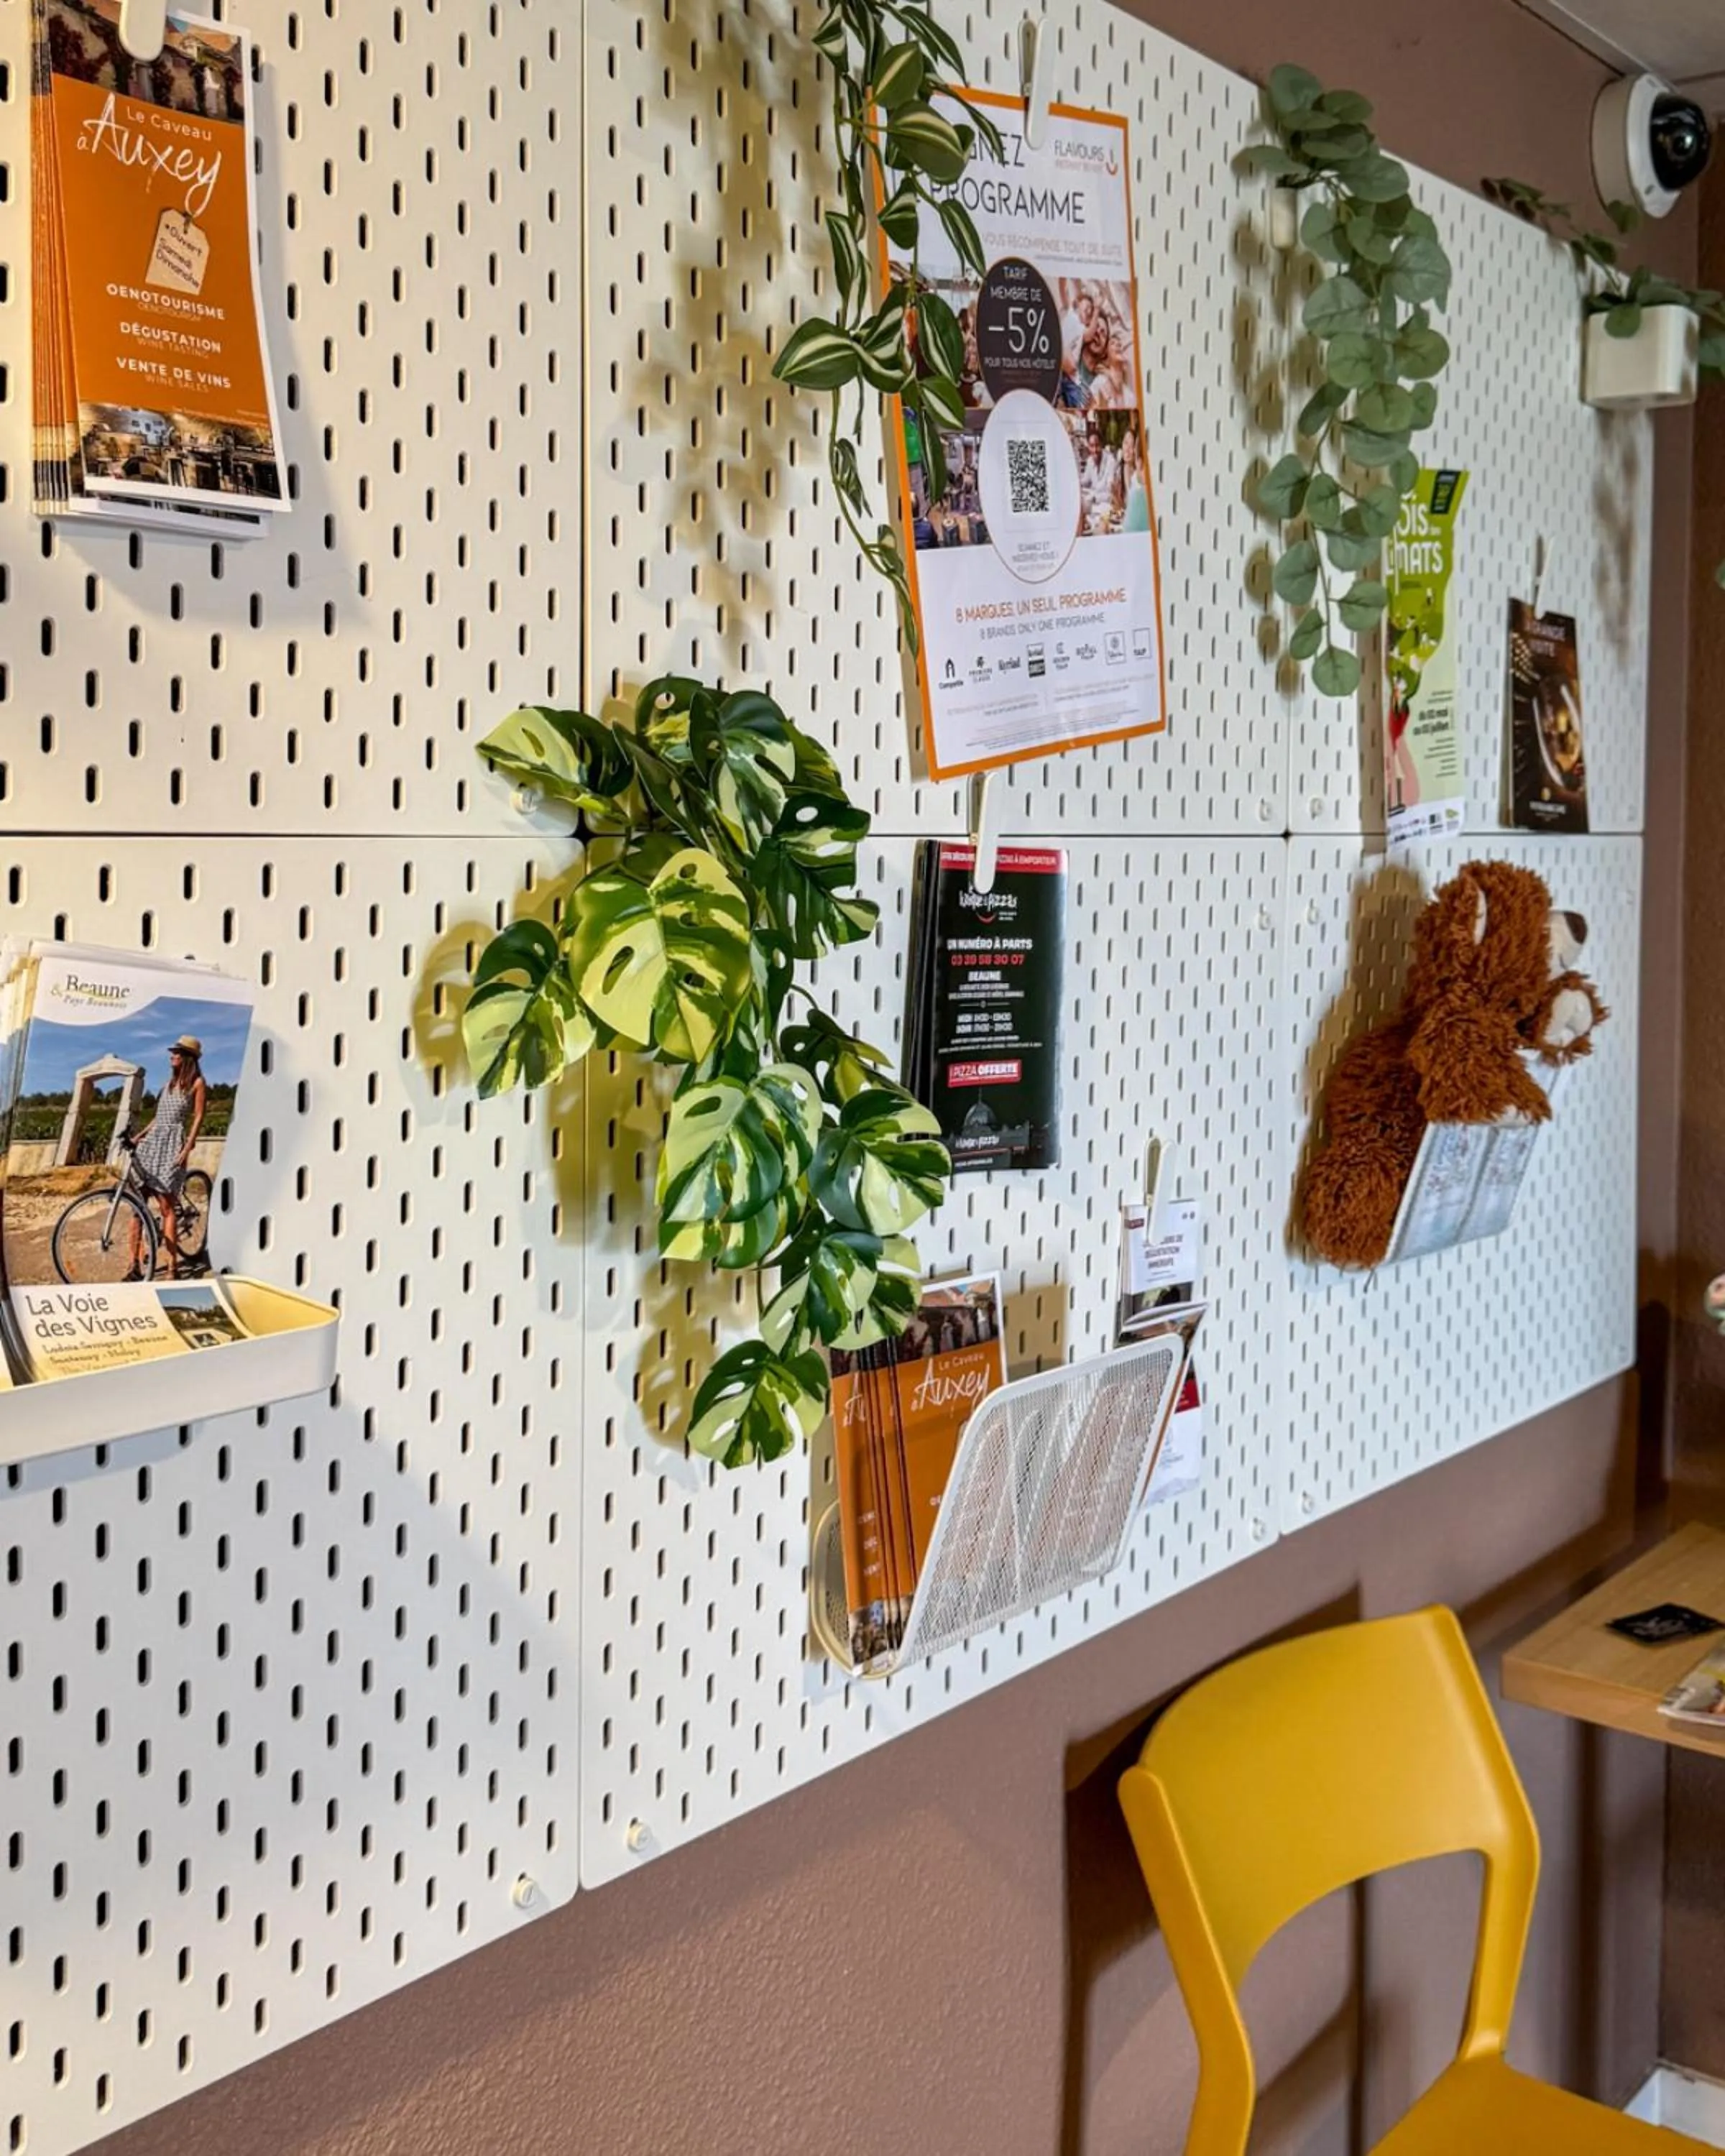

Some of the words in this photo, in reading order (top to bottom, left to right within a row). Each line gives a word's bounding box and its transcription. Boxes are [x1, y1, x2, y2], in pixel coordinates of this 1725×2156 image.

[126, 106, 144, 123] Le
[150, 114, 212, 141] Caveau
[83, 92, 222, 218] Auxey
[1054, 139, 1105, 162] FLAVOURS
[170, 226, 202, 257] Ouvert
[1003, 265, 1029, 281] TARIF
[106, 283, 226, 321] OENOTOURISME
[990, 285, 1029, 301] MEMBRE
[1030, 288, 1042, 302] DE
[120, 321, 222, 354] DÉGUSTATION
[116, 356, 167, 376] VENTE
[172, 367, 193, 382] DE
[197, 372, 231, 389] VINS
[955, 607, 964, 624] 8
[1016, 600, 1031, 615] UN
[1031, 595, 1057, 613] SEUL
[1059, 587, 1127, 610] PROGRAMME
[1055, 612, 1105, 630] PROGRAMME
[947, 938, 957, 949] UN
[958, 936, 992, 949] NUMÉRO
[993, 936, 1001, 949] À
[1002, 938, 1033, 949] PARTS
[1011, 954, 1025, 965] 07
[67, 975, 130, 998] Beaune
[967, 970, 1001, 982] BEAUNE
[978, 1062, 1018, 1076] OFFERTE
[25, 1294, 55, 1316] La
[57, 1293, 109, 1314] Voie
[36, 1319, 74, 1338] des
[78, 1314, 158, 1336] Vignes
[938, 1360, 949, 1371] Le
[914, 1357, 990, 1411] Auxey
